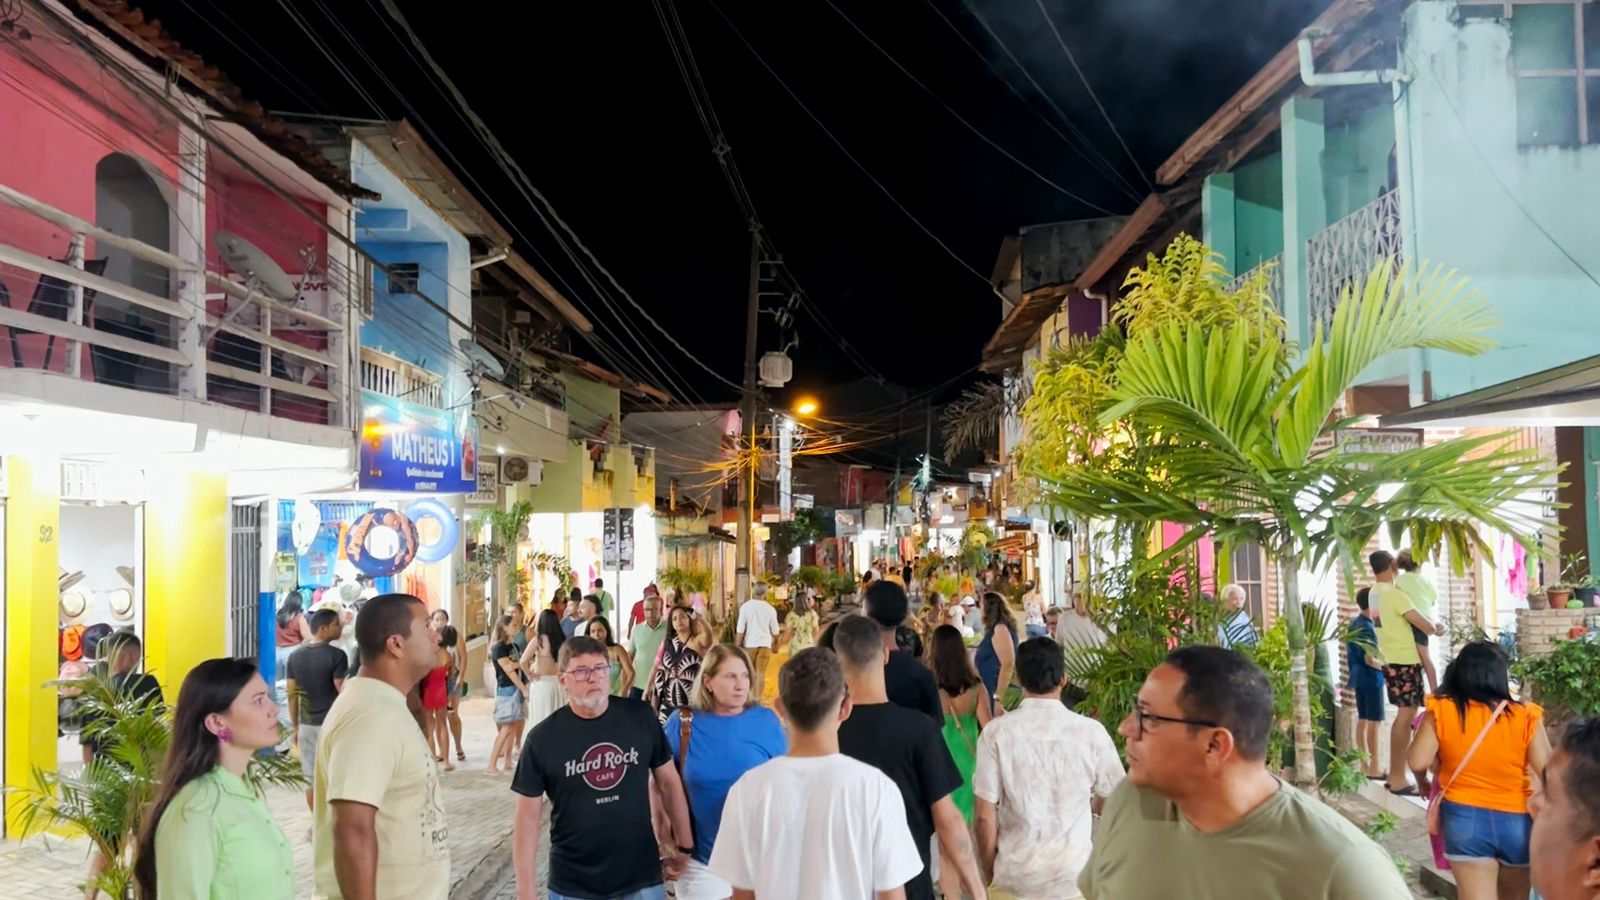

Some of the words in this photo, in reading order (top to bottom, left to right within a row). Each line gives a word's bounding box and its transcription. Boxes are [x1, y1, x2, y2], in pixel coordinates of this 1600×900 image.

[392, 433, 450, 466] MATHEUS
[450, 441, 455, 467] 1
[39, 524, 53, 544] 92
[564, 753, 601, 777] Hard
[604, 747, 639, 768] Rock
[596, 772, 615, 782] CAFE
[596, 795, 619, 805] BERLIN
